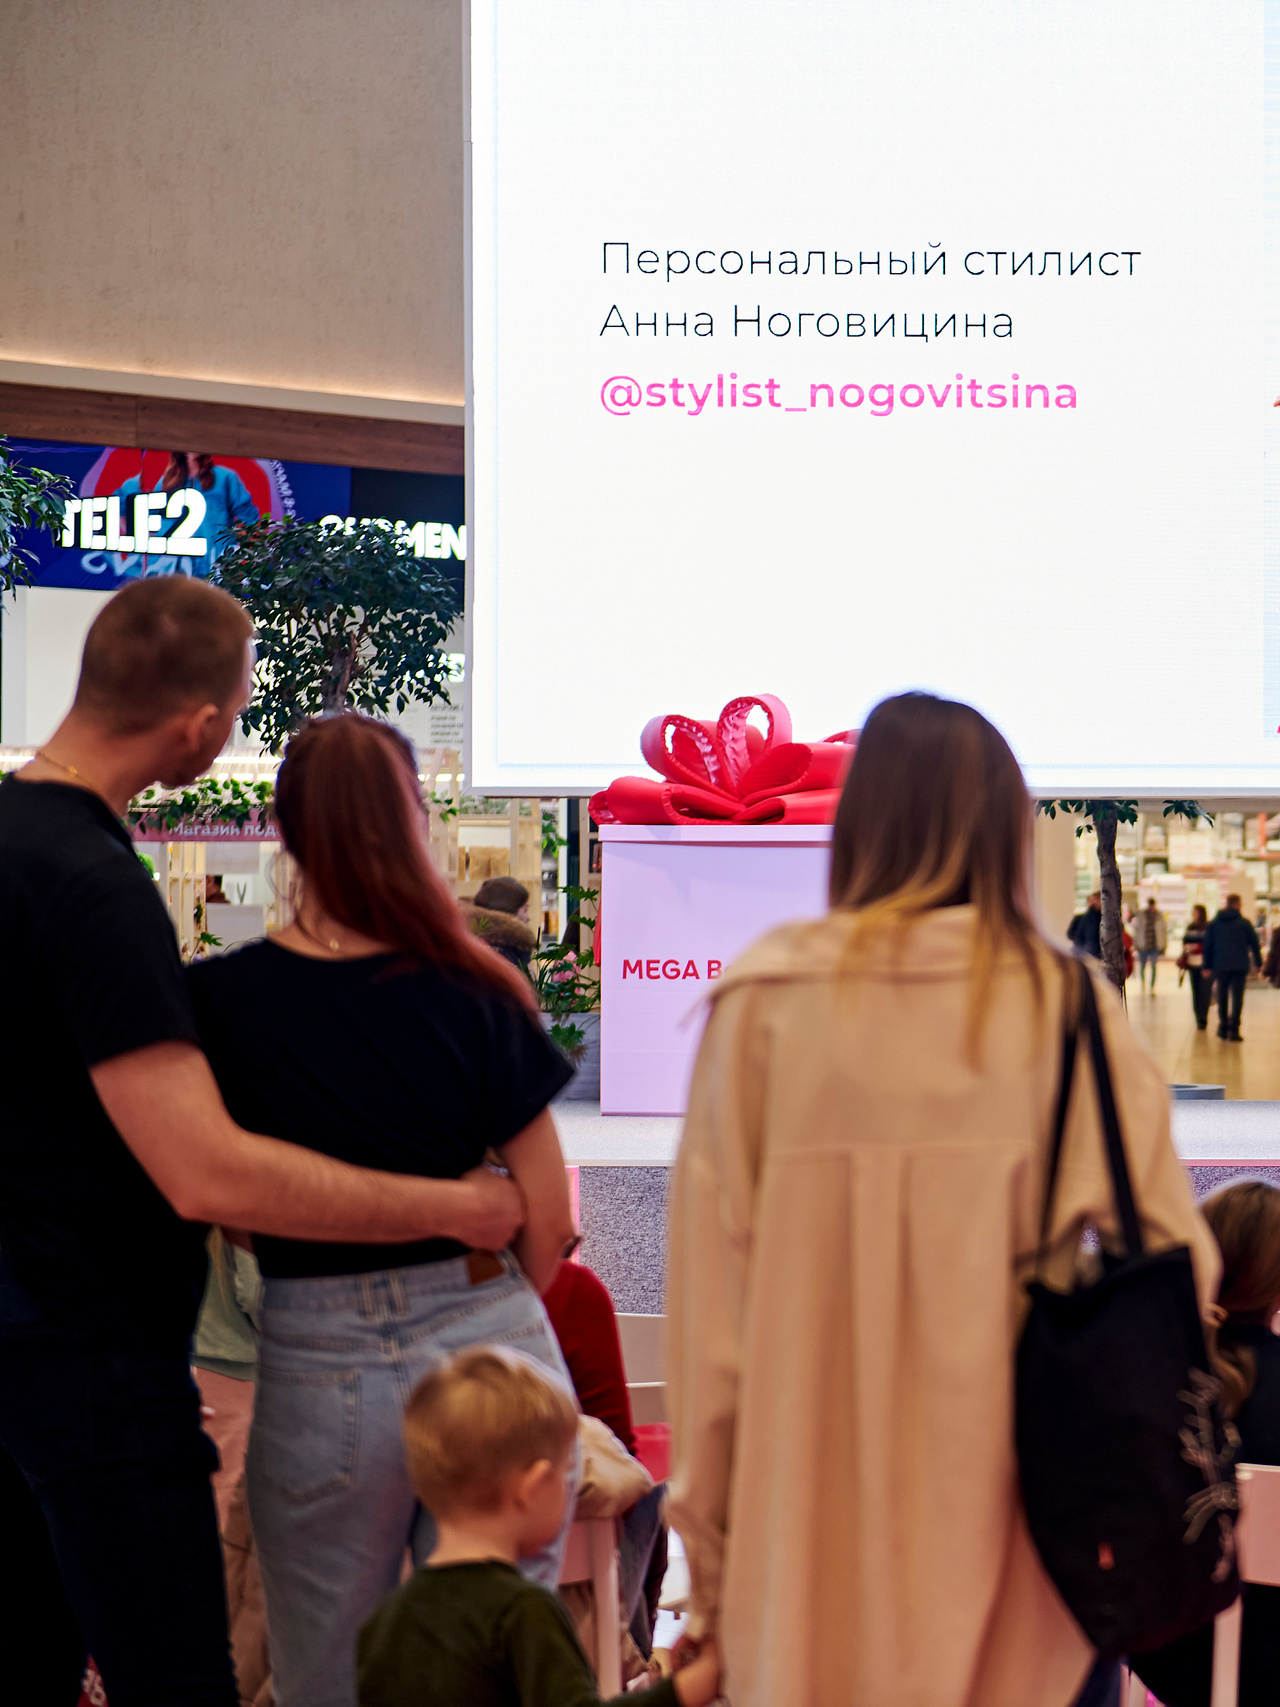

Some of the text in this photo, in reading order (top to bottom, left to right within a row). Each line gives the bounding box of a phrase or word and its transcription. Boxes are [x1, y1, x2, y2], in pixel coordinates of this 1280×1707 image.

[603, 241, 1142, 283] Персональный стилист
[600, 304, 1013, 343] Анна Ноговицина
[600, 372, 1077, 417] @stylist_nogovitsina
[61, 487, 208, 557] TELE2
[169, 821, 280, 838] Магазин под
[622, 958, 733, 981] MEGA B
